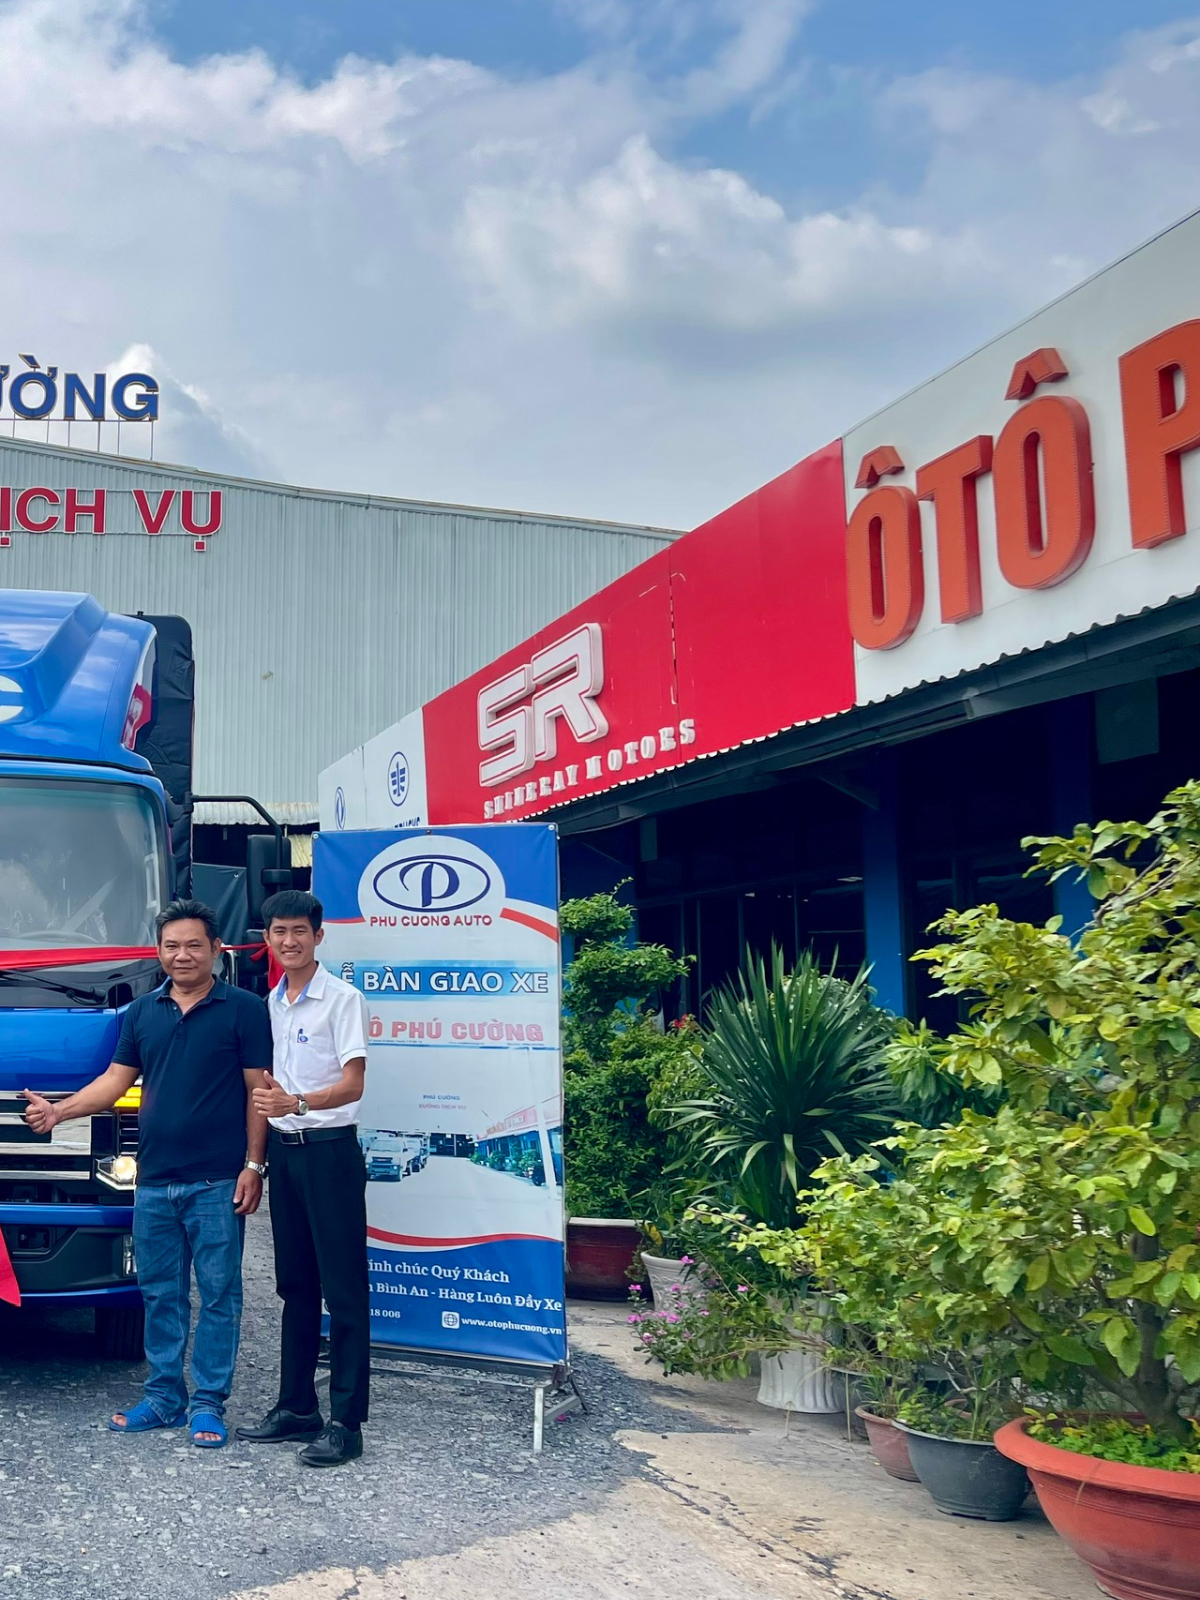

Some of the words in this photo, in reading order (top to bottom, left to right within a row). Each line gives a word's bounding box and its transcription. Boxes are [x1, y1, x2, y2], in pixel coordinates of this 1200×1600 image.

[131, 489, 224, 552] VỤ
[483, 764, 579, 820] SHINERAY
[585, 718, 697, 780] MOTORS
[370, 916, 397, 927] PHU
[401, 915, 450, 927] CUONG
[453, 914, 492, 926] AUTO
[363, 966, 420, 992] BÀN
[429, 971, 504, 993] GIAO
[510, 972, 548, 993] XE
[391, 1017, 442, 1039] PHÚ
[451, 1019, 544, 1042] CƯỜNG
[367, 1259, 393, 1273] ính
[395, 1261, 429, 1276] chúc
[431, 1265, 461, 1281] Quý
[463, 1268, 510, 1283] Khách
[376, 1282, 408, 1295] Bình
[409, 1285, 429, 1297] An
[438, 1288, 475, 1303] Hàng
[477, 1292, 512, 1306] Luôn
[514, 1293, 542, 1311] Đầy
[543, 1299, 562, 1312] Xe
[382, 1309, 401, 1319] 006
[461, 1317, 562, 1336] www.otophucuong.vn
